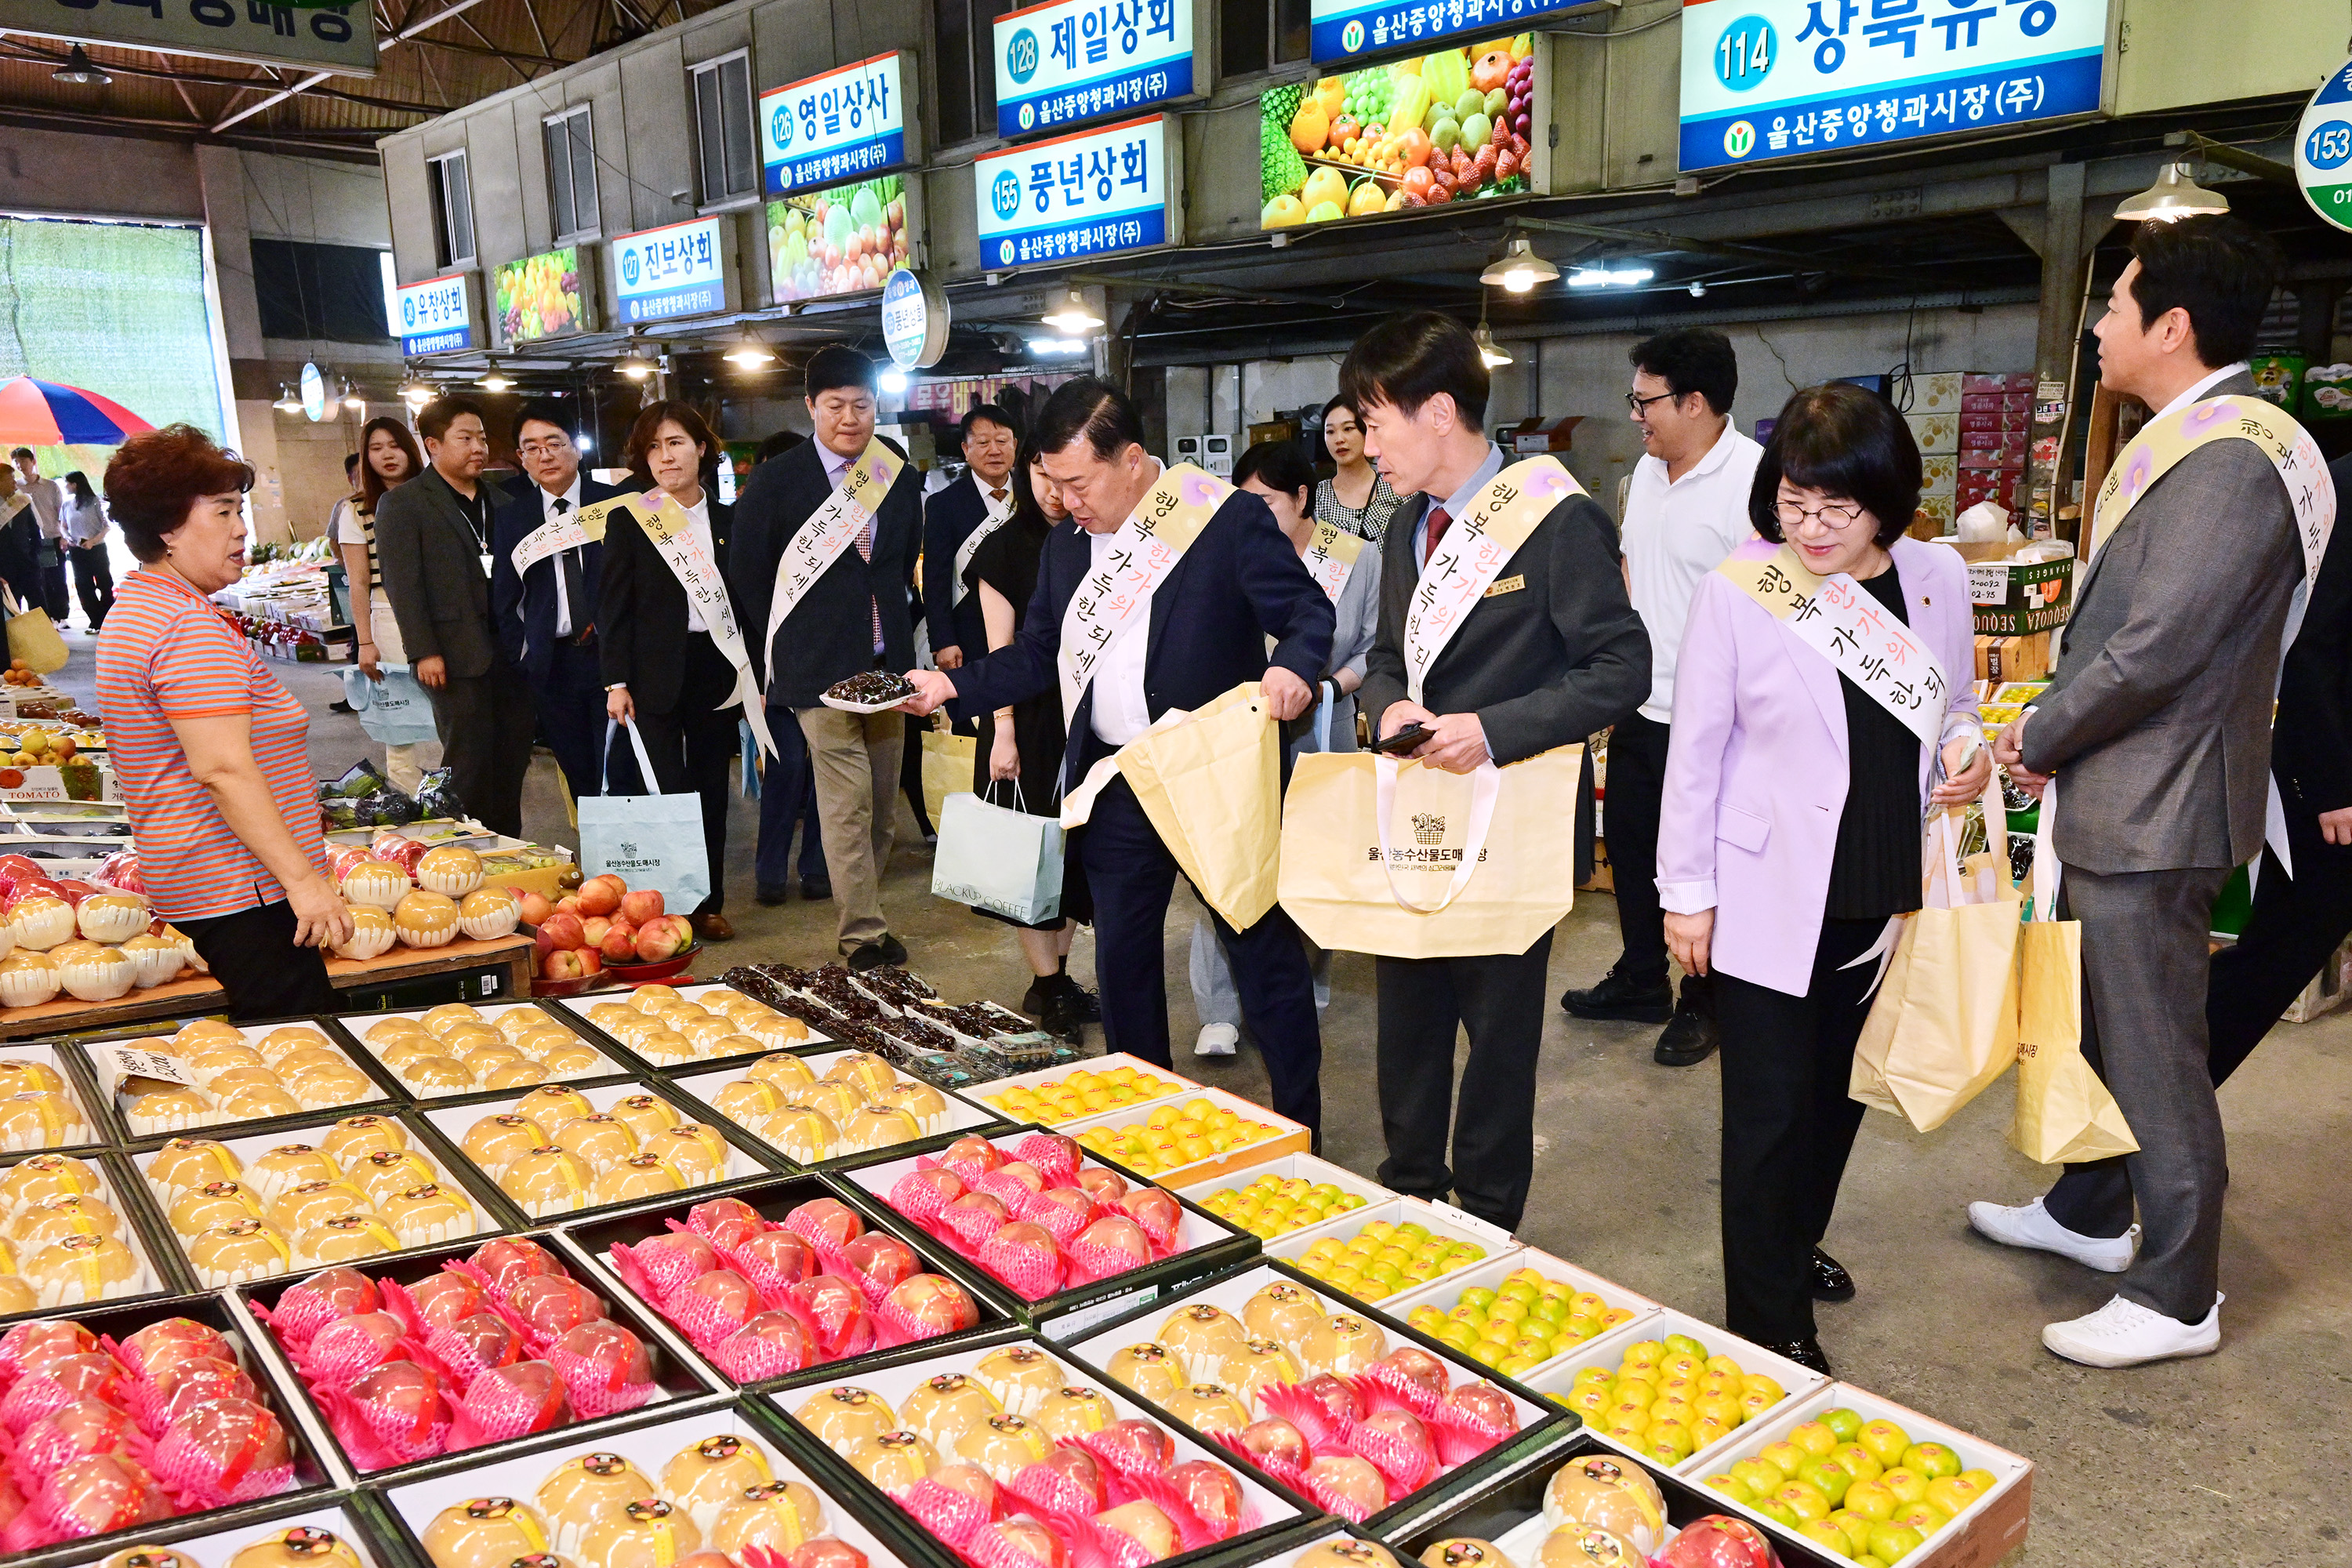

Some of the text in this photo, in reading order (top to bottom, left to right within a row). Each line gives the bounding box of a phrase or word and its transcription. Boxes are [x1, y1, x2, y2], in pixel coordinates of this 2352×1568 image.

[1010, 0, 1174, 74] 128 제일상회
[1373, 0, 1561, 45] 울산중앙청과시
[1720, 27, 1770, 81] 114
[773, 73, 888, 143] 126 영일상사
[1040, 71, 1167, 124] 울산중앙청과시장(주)
[1767, 75, 2045, 151] 울산중앙청과시장(주)
[795, 143, 887, 184] 울산중앙청과시장(주)
[2310, 128, 2350, 161] 153
[995, 139, 1147, 213] 155 풍년상회
[624, 230, 713, 281] 127 진보상회
[1019, 220, 1142, 261] 울산중앙청과시장(주)
[419, 286, 462, 324] 유창상회
[895, 303, 924, 331] 풍년상회
[2241, 419, 2298, 470] 행복
[519, 507, 604, 554] 행복 가득한
[797, 470, 869, 554] 행복 가득한
[1464, 483, 1519, 543] 행복
[535, 528, 586, 556] 한가위
[645, 514, 711, 603] 행복 가득한
[786, 505, 866, 602] 한가위 되세요
[1077, 491, 1178, 622] 행복 가득한
[1311, 527, 1338, 564] 행복
[677, 529, 735, 640] 한가위 되세요
[1410, 553, 1459, 644] 가득한
[1429, 543, 1501, 637] 한가위
[2028, 563, 2071, 580] ORANGES
[1073, 543, 1171, 690] 한가위 되세요
[1757, 564, 1922, 710] 행복 가득한
[1824, 581, 1918, 666] 한가위
[1368, 847, 1488, 862] 울농수산물도매장
[934, 878, 1029, 920] BLACKUP COFFEE
